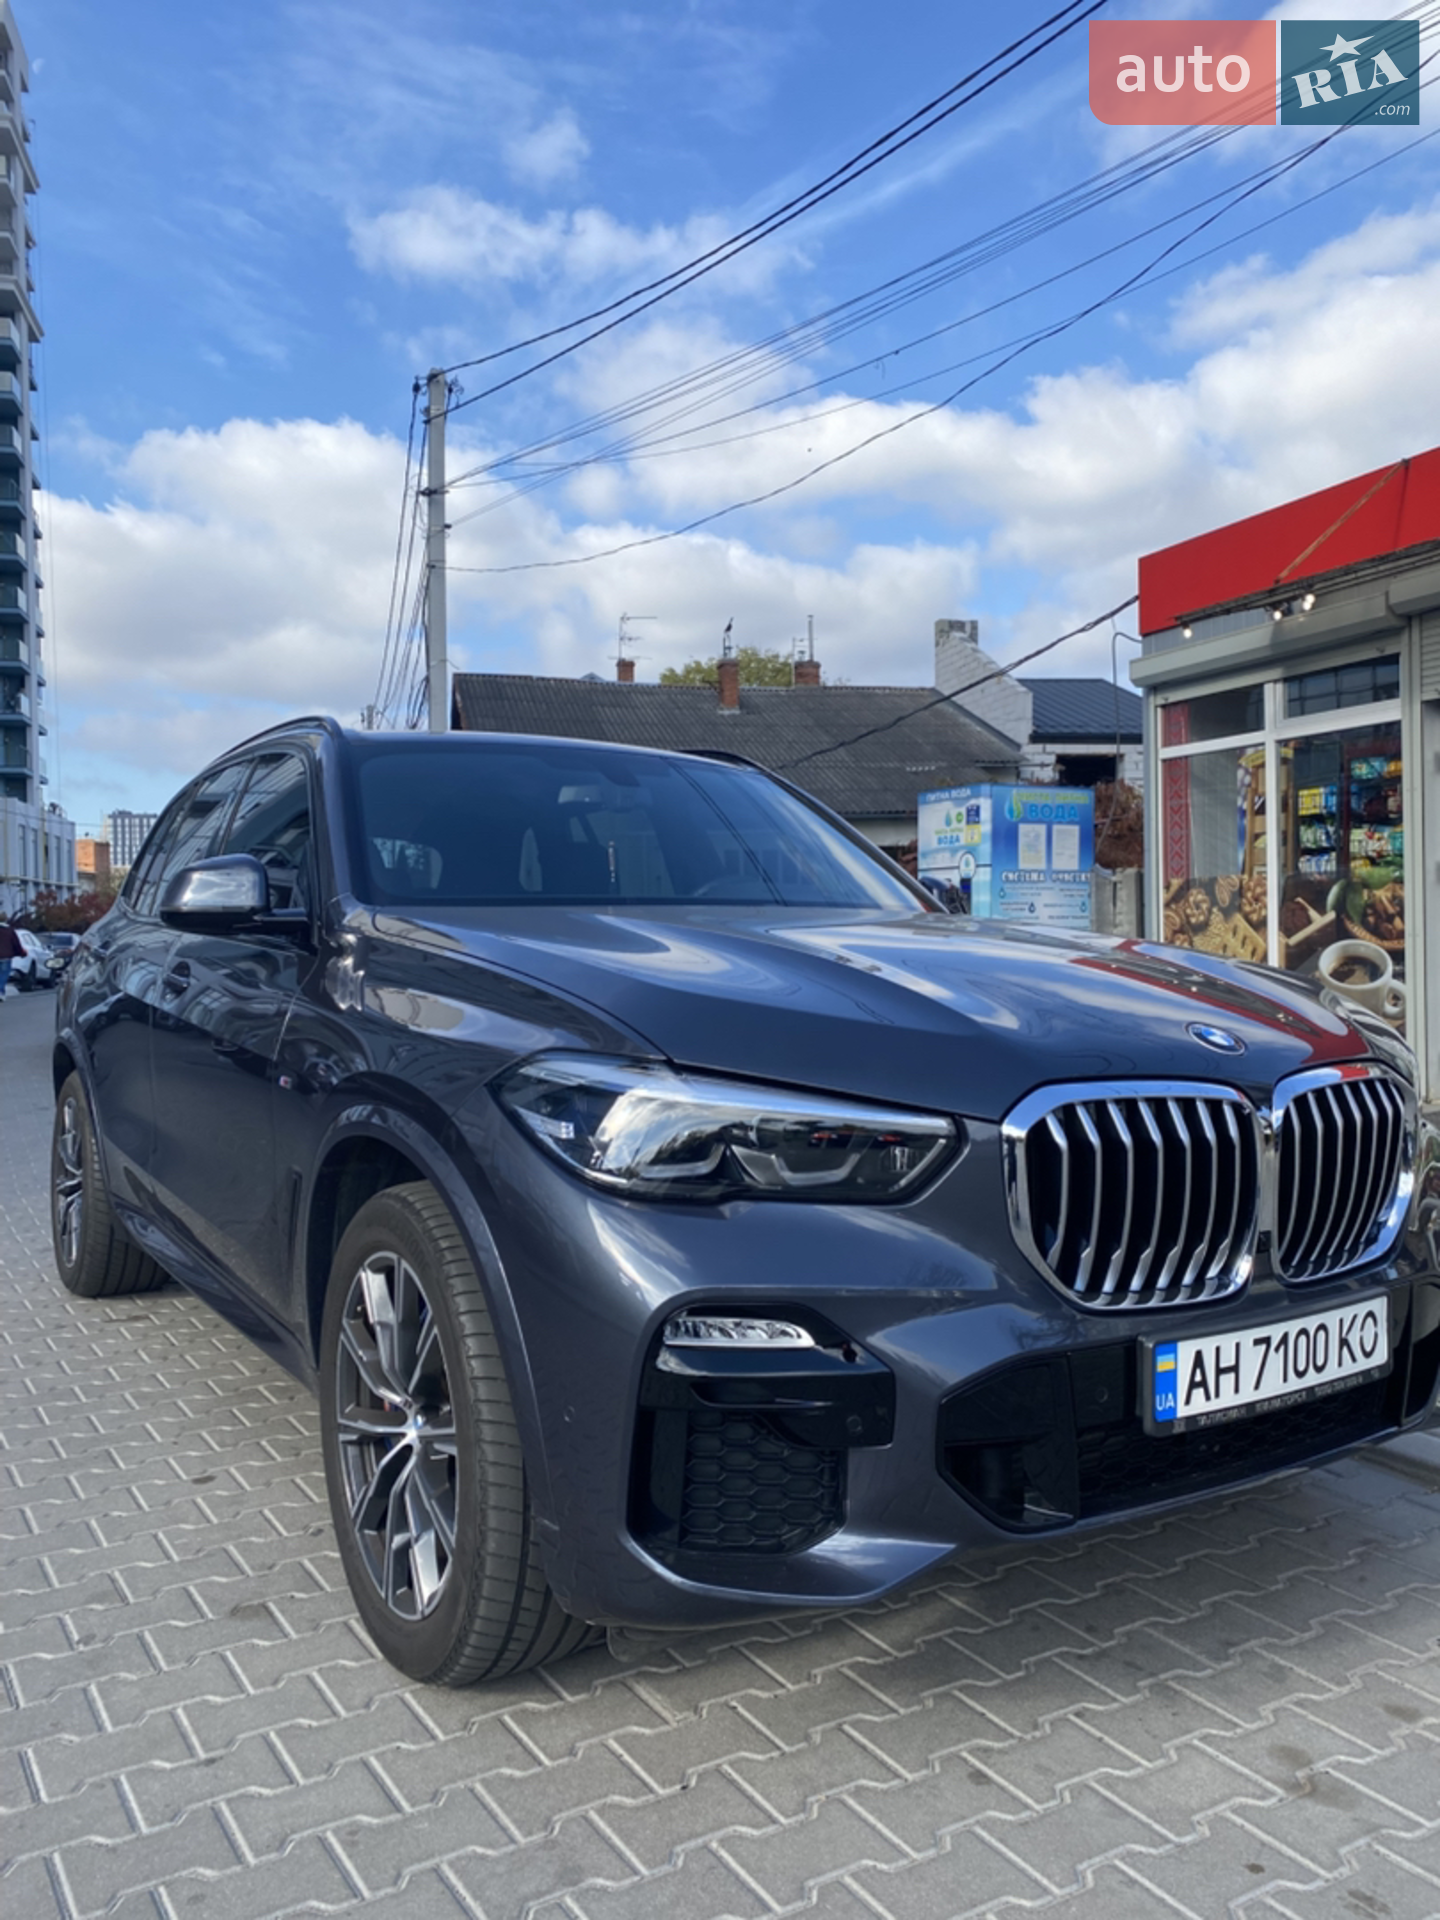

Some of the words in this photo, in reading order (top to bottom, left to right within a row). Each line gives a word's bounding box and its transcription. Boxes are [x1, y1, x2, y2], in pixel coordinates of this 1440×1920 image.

[1027, 803, 1079, 821] ВОДА
[937, 834, 961, 846] ВОДА
[1184, 1341, 1241, 1406] AH
[1253, 1322, 1329, 1391] 7100
[1337, 1310, 1379, 1368] KO
[1155, 1393, 1176, 1411] UA
